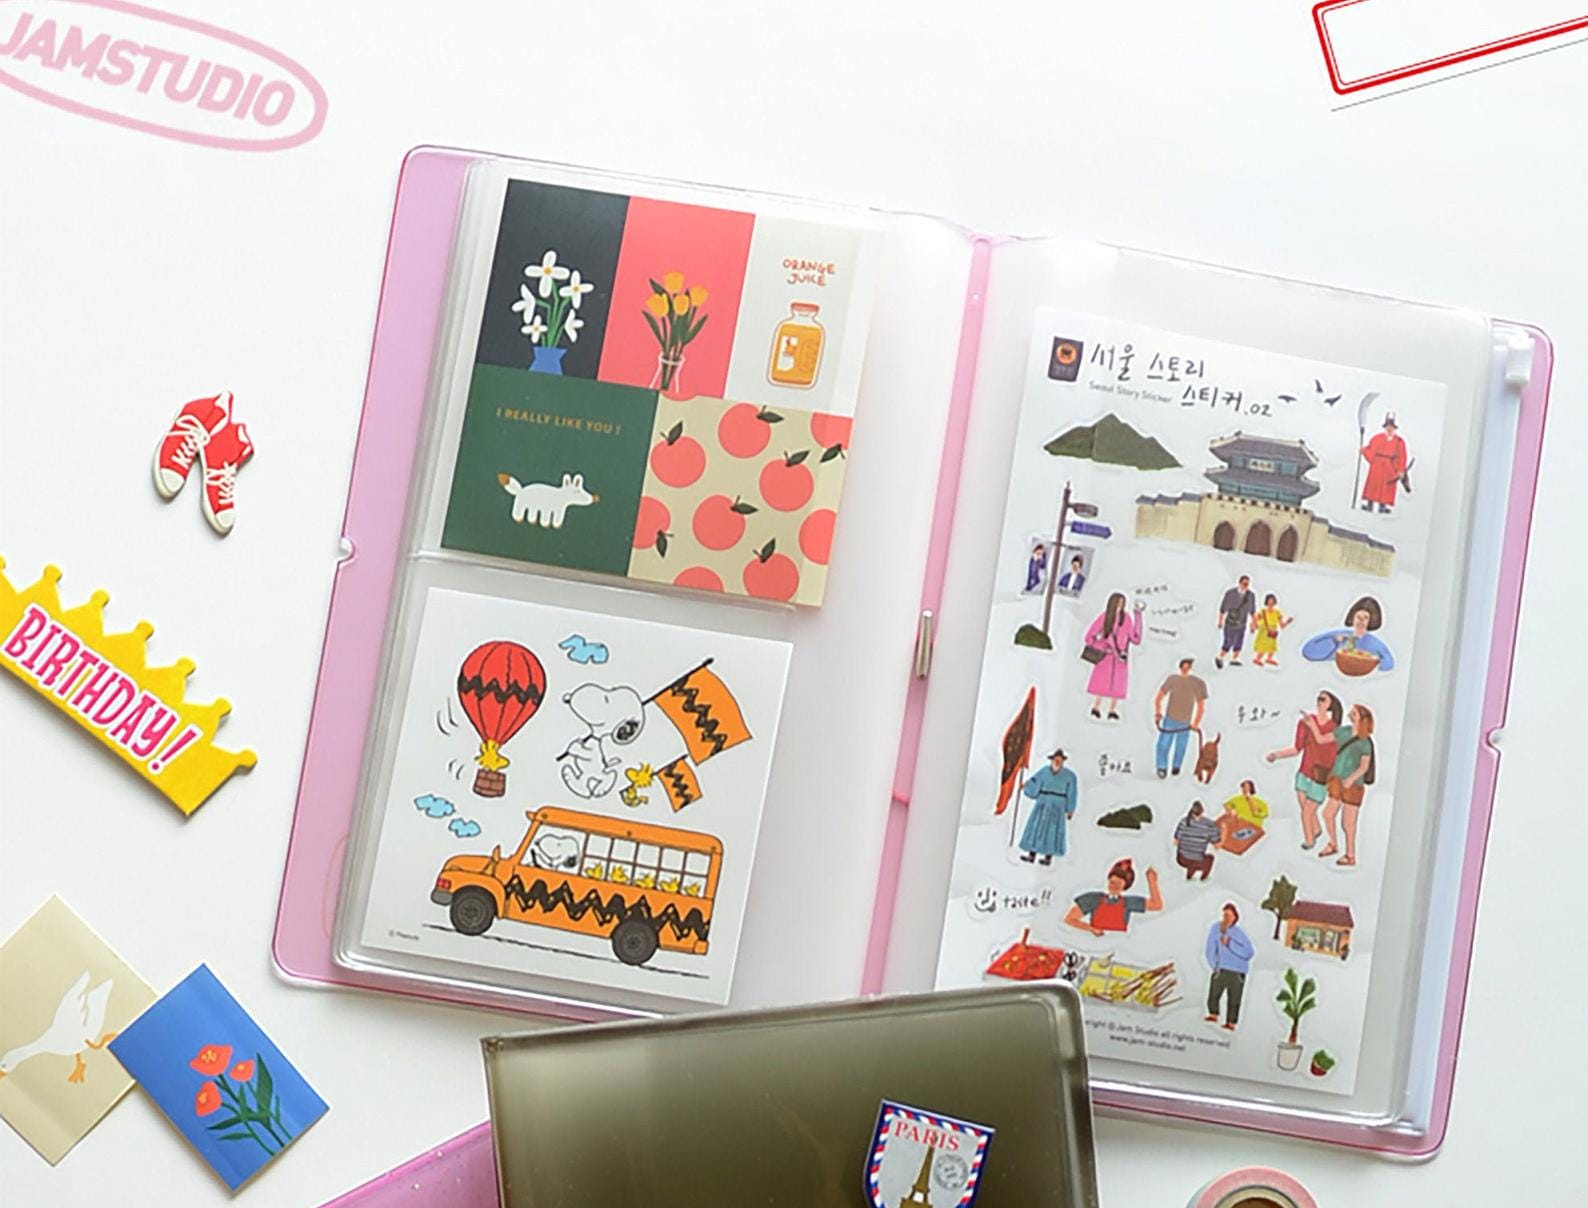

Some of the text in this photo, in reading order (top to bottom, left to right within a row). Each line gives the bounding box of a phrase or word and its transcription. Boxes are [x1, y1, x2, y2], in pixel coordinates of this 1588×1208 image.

[782, 258, 835, 274] ORANGE
[786, 273, 826, 287] JUICE
[1090, 343, 1204, 382] 서울 스토리
[496, 407, 502, 418] I
[504, 407, 552, 424] REALLY
[554, 415, 581, 429] LIKE
[586, 419, 613, 434] YOU
[4, 606, 199, 771] BIRTHDAY!
[894, 1120, 960, 1152] PARIS
